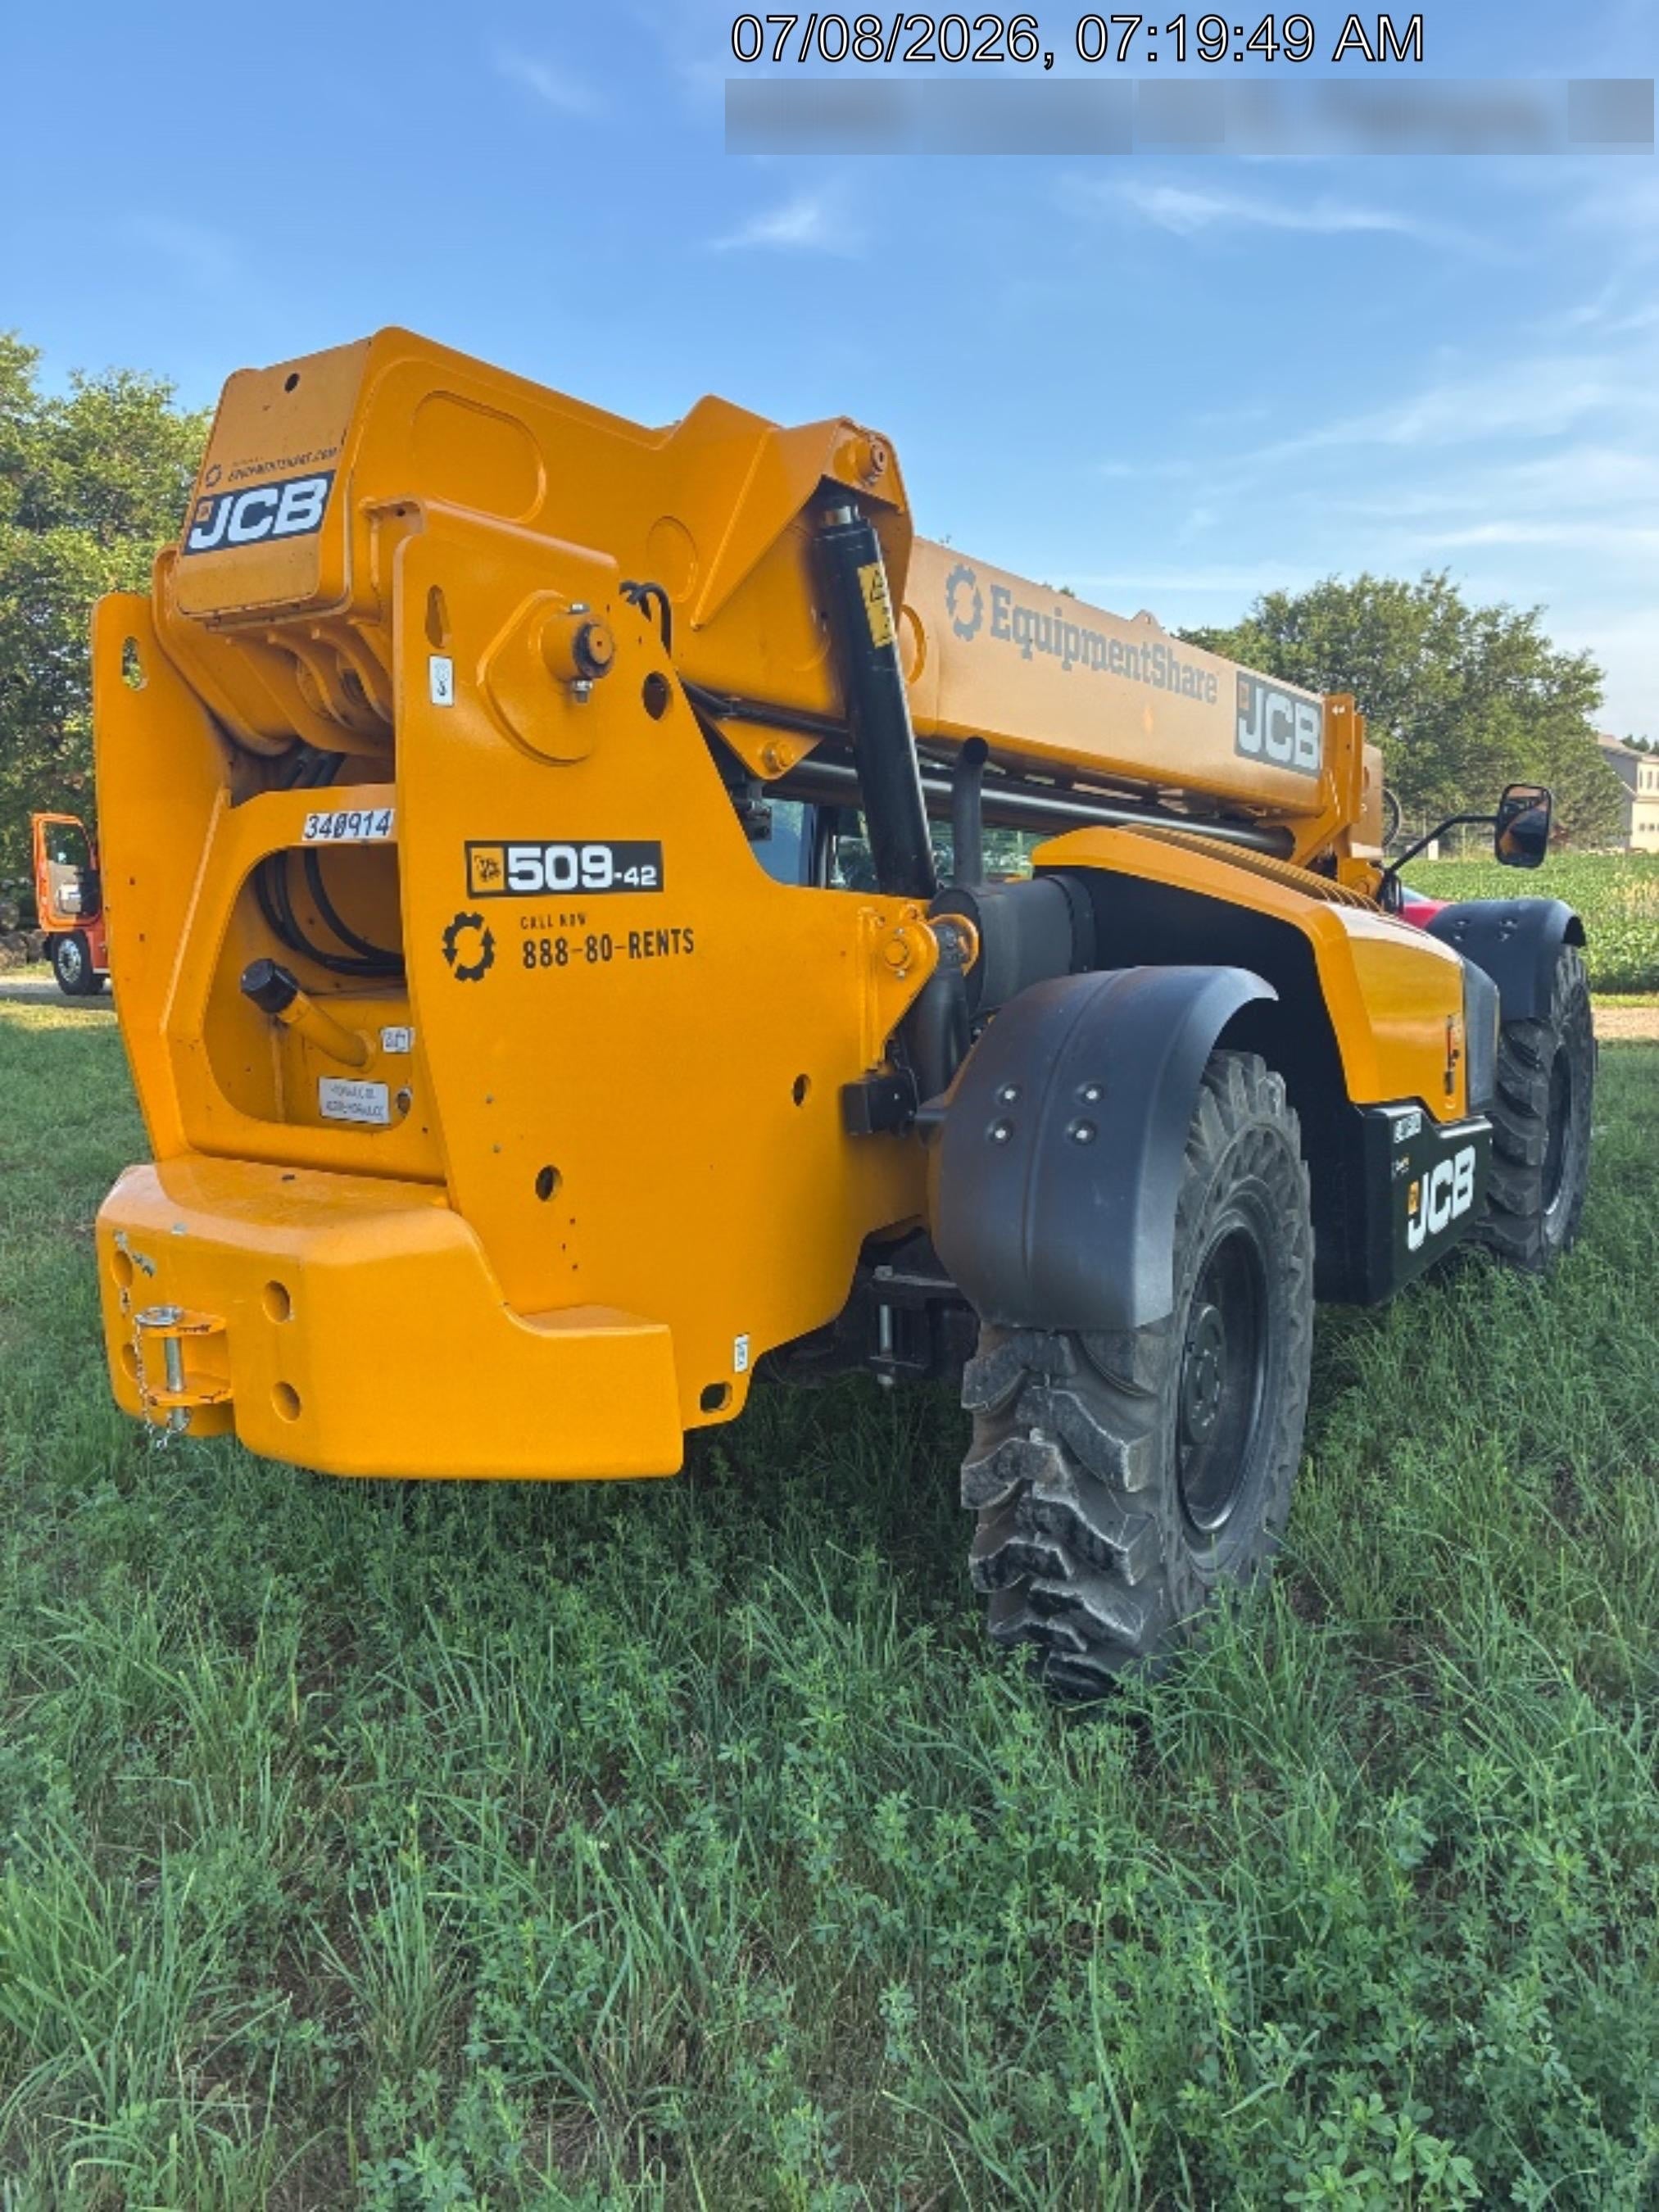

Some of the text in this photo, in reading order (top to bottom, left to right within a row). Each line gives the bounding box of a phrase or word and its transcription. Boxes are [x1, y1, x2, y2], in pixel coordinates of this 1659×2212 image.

[188, 478, 328, 549] JCB
[990, 584, 1218, 705] EquipmentShare
[1239, 686, 1320, 770] JCB
[523, 928, 695, 969] 888-80-RENTS
[1407, 1145, 1475, 1252] JCB
